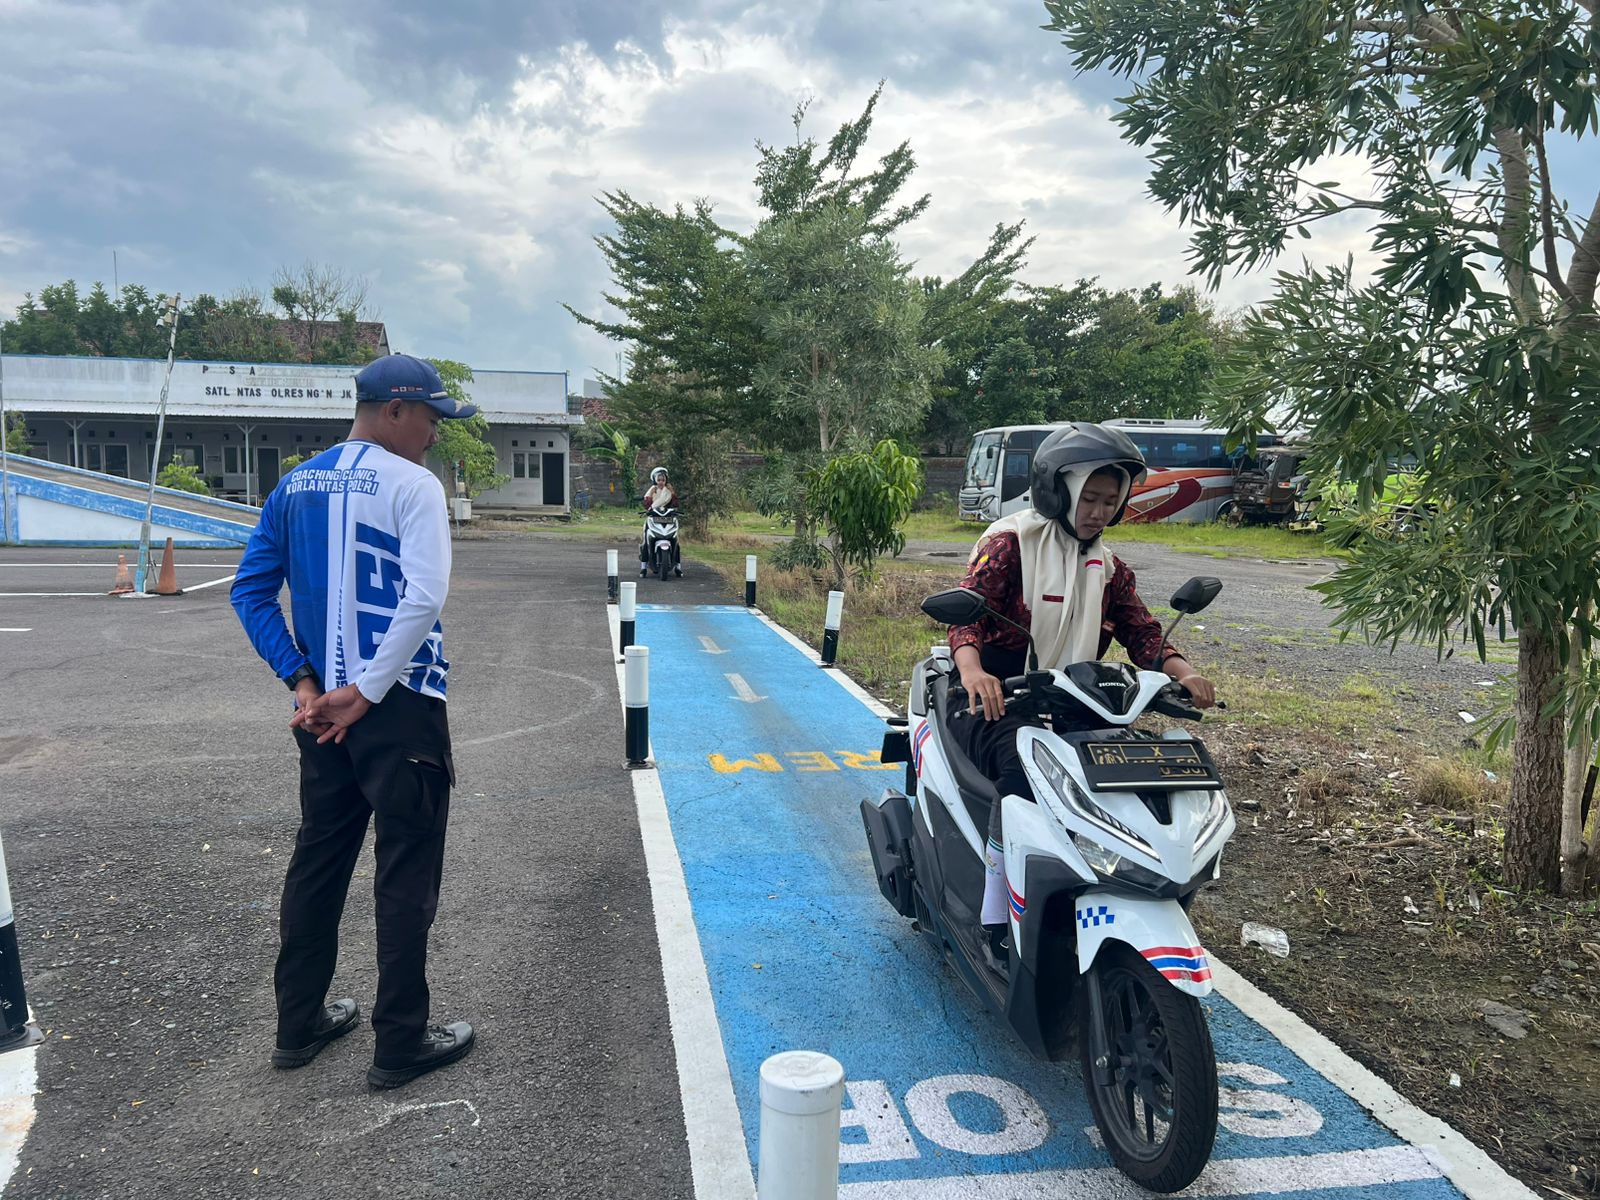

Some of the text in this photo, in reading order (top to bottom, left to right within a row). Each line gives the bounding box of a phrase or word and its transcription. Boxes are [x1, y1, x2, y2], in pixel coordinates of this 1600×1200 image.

[291, 468, 377, 482] COACHING CLINIC
[286, 480, 345, 495] KORLANTAS
[707, 750, 901, 774] REM
